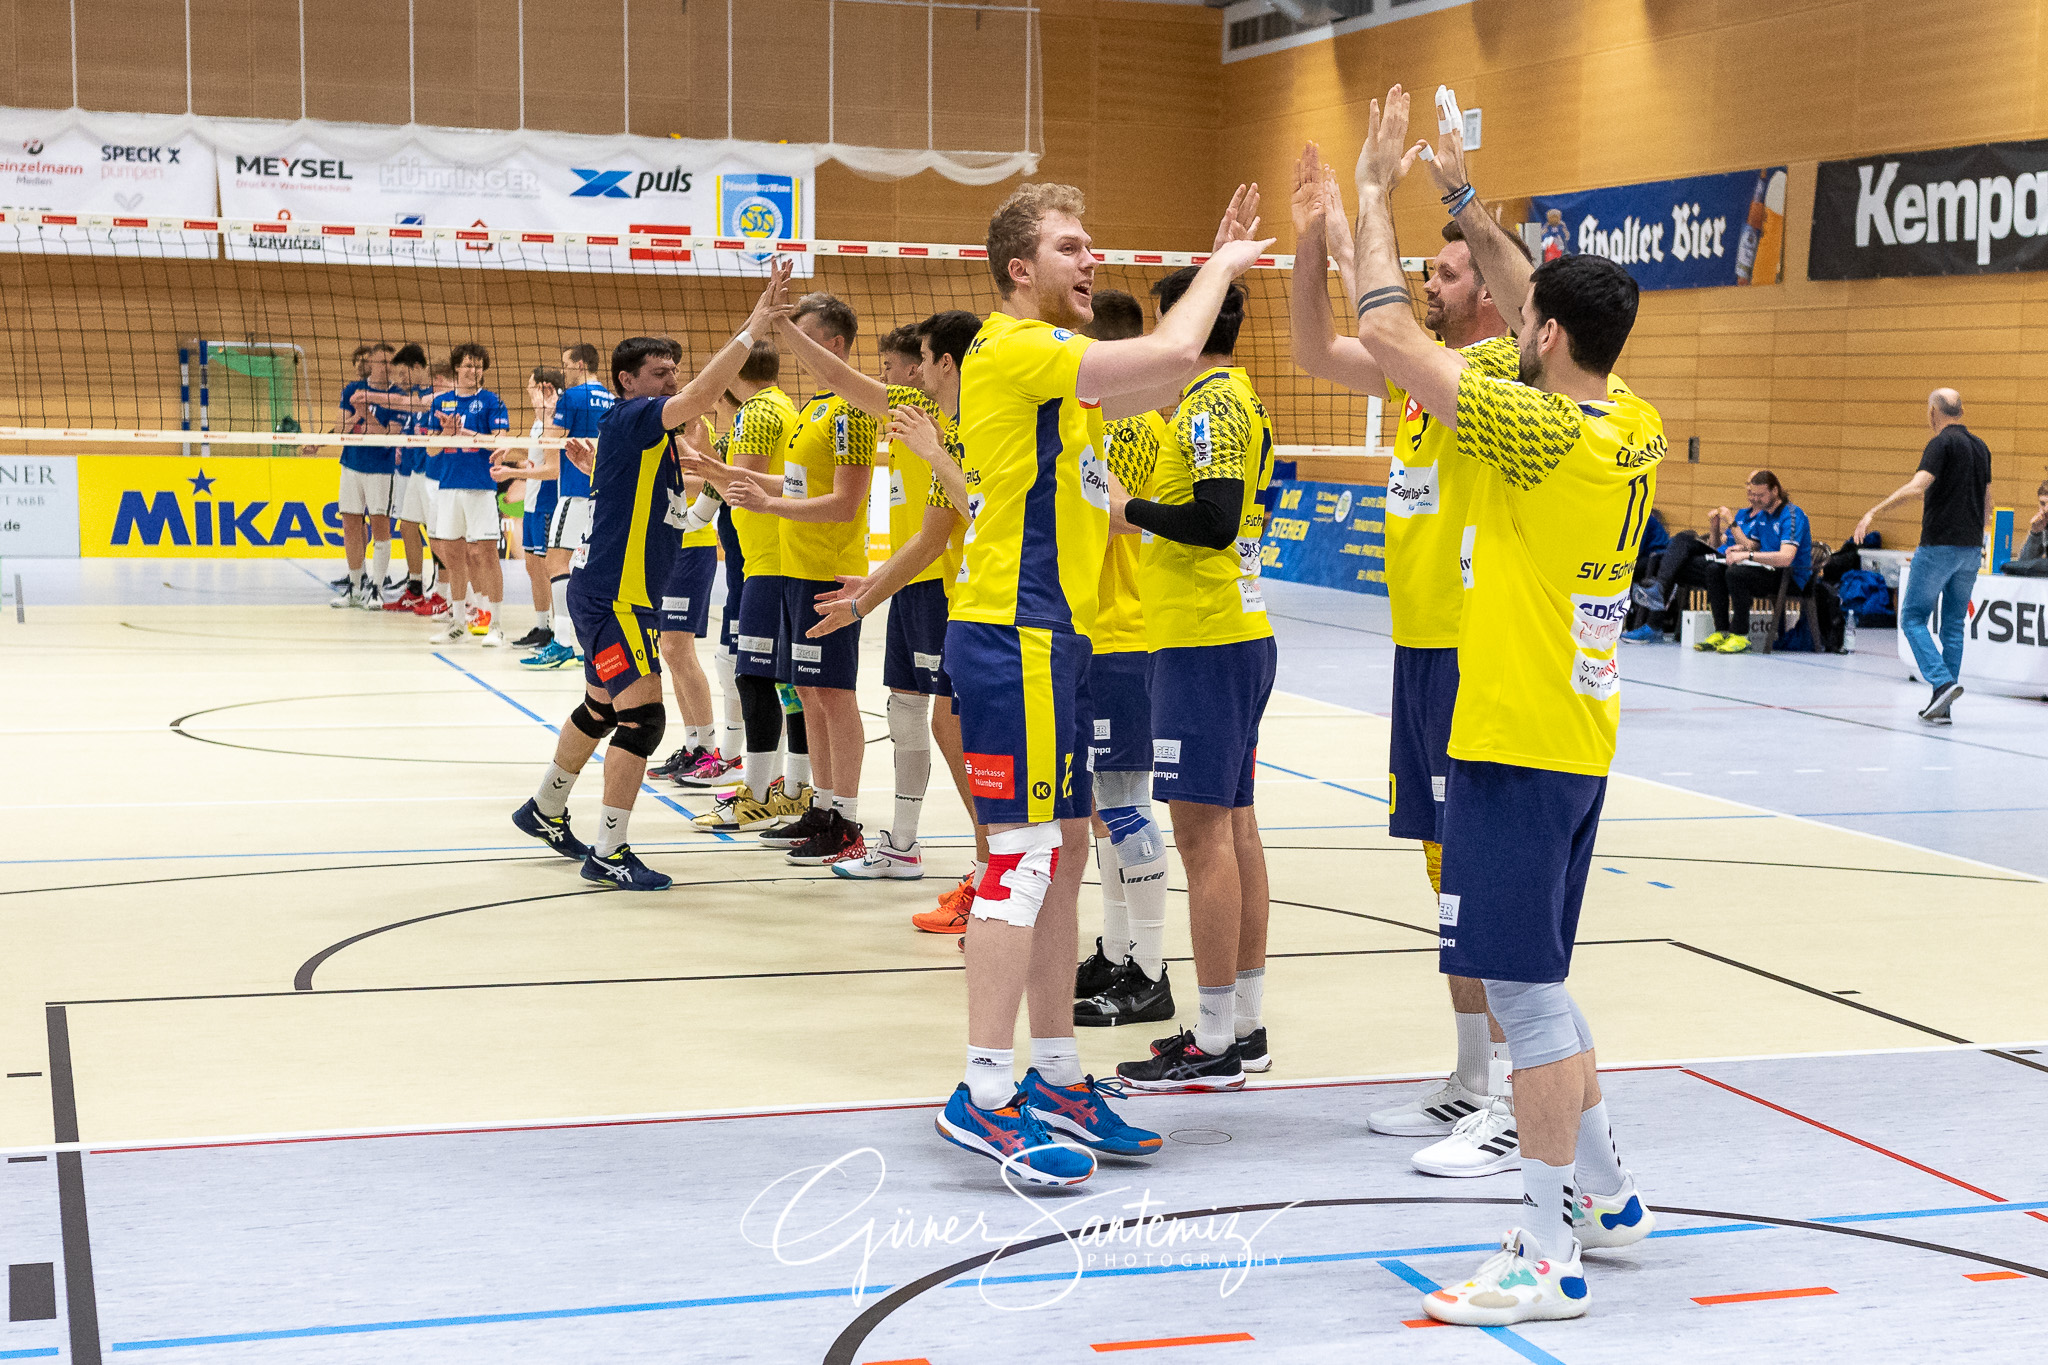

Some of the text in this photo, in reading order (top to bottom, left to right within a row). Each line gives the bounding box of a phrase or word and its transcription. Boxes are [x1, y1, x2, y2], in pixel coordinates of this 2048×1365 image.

[101, 145, 161, 163] SPECK
[236, 156, 353, 180] MEYSEL
[635, 166, 693, 199] puls
[1855, 161, 2048, 265] Kempa
[1671, 202, 1727, 262] Bier
[1616, 473, 1648, 551] 11
[1576, 561, 1606, 580] SV
[750, 656, 772, 665] Kempa
[798, 665, 821, 674] Kempa
[974, 768, 1006, 778] Sparkasse
[975, 779, 1003, 790] Nürnberg
[1440, 937, 1456, 948] pa
